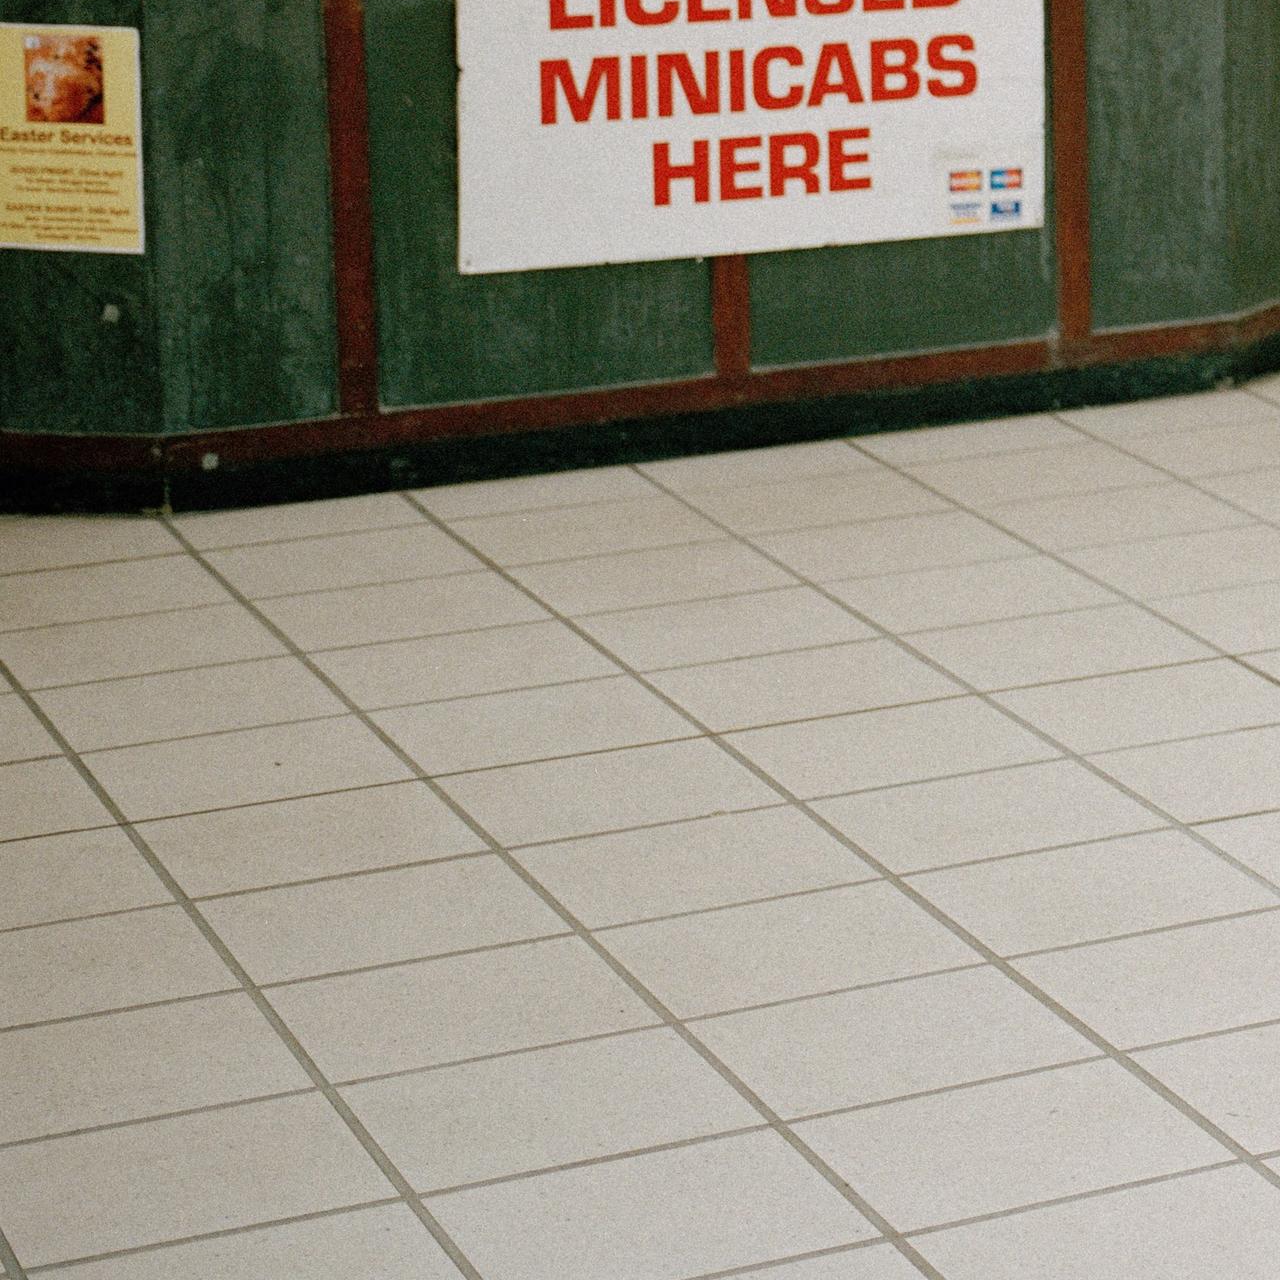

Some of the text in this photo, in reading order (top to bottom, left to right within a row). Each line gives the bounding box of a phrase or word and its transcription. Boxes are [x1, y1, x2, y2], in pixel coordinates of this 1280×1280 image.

[540, 34, 979, 125] MINICABS
[60, 128, 133, 145] Services
[653, 128, 872, 206] HERE
